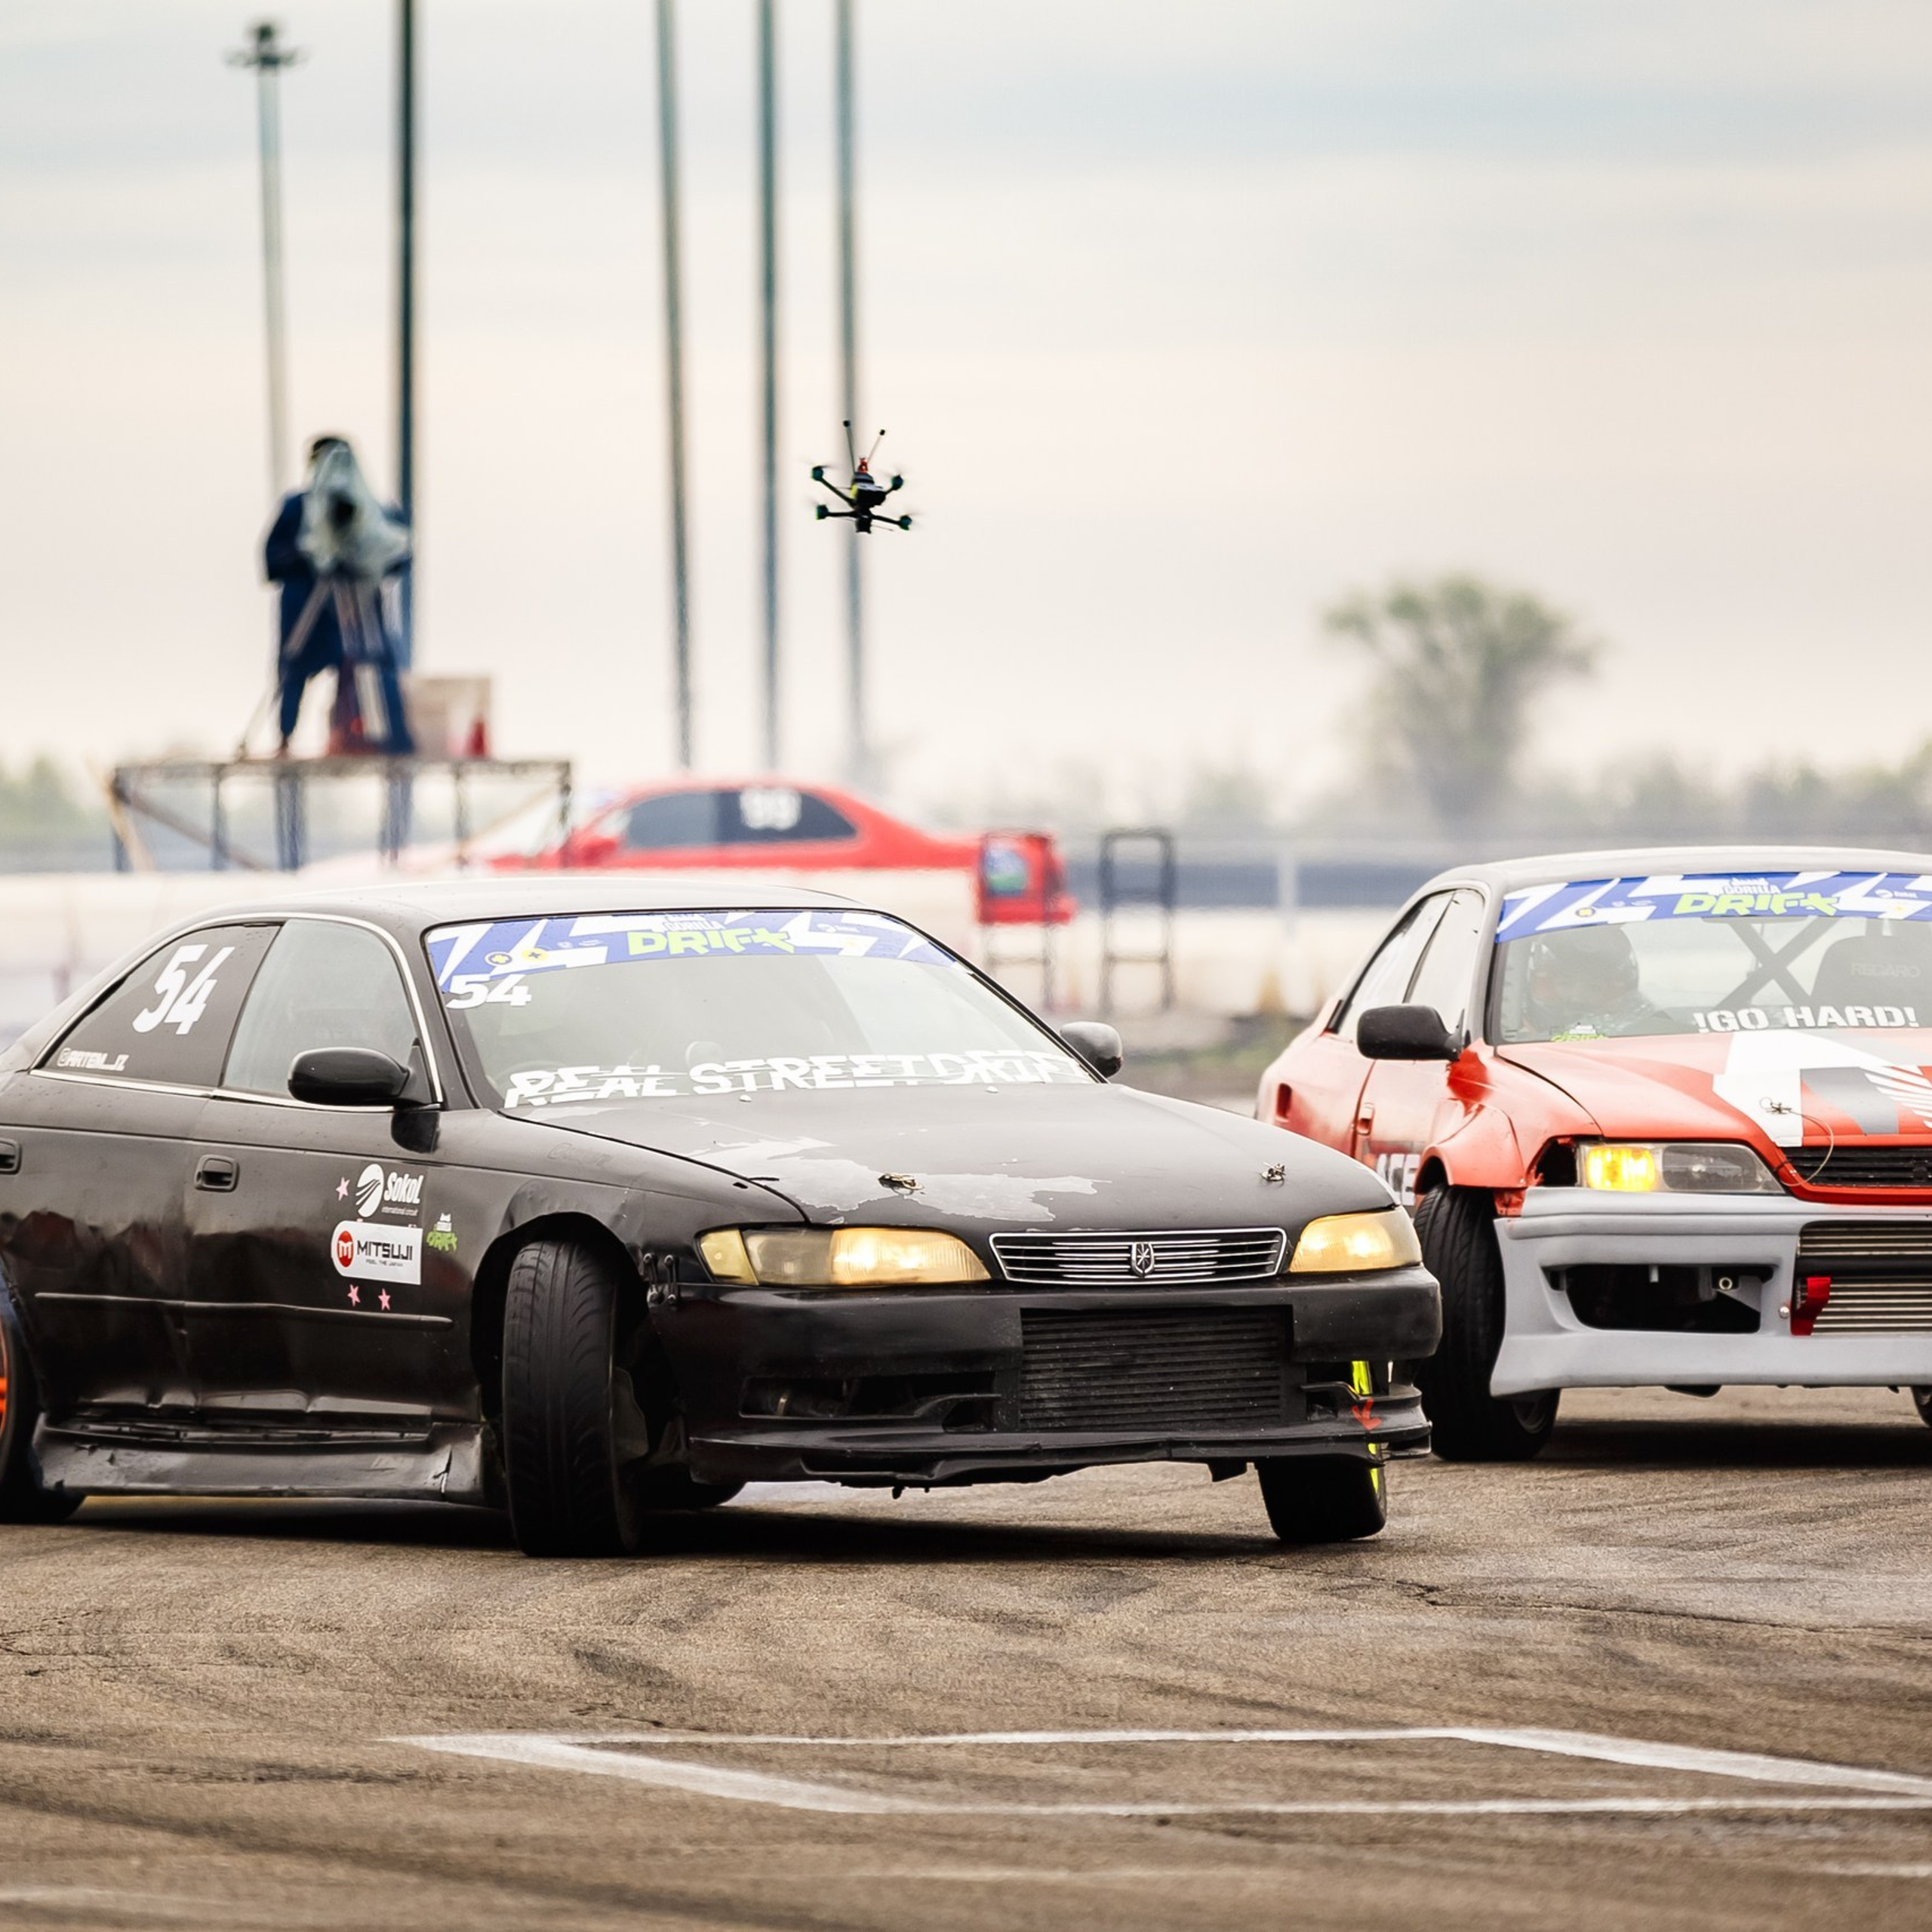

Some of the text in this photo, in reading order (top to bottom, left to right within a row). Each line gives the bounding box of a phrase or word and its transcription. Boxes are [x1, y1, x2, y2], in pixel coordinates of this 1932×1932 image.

[1851, 962, 1921, 978] RECARO
[132, 944, 235, 1035] 54
[445, 974, 532, 1009] 54
[1693, 1005, 1919, 1033] !GO HARD!
[504, 1065, 679, 1109] REAL
[357, 1240, 413, 1261] MITSUJI
